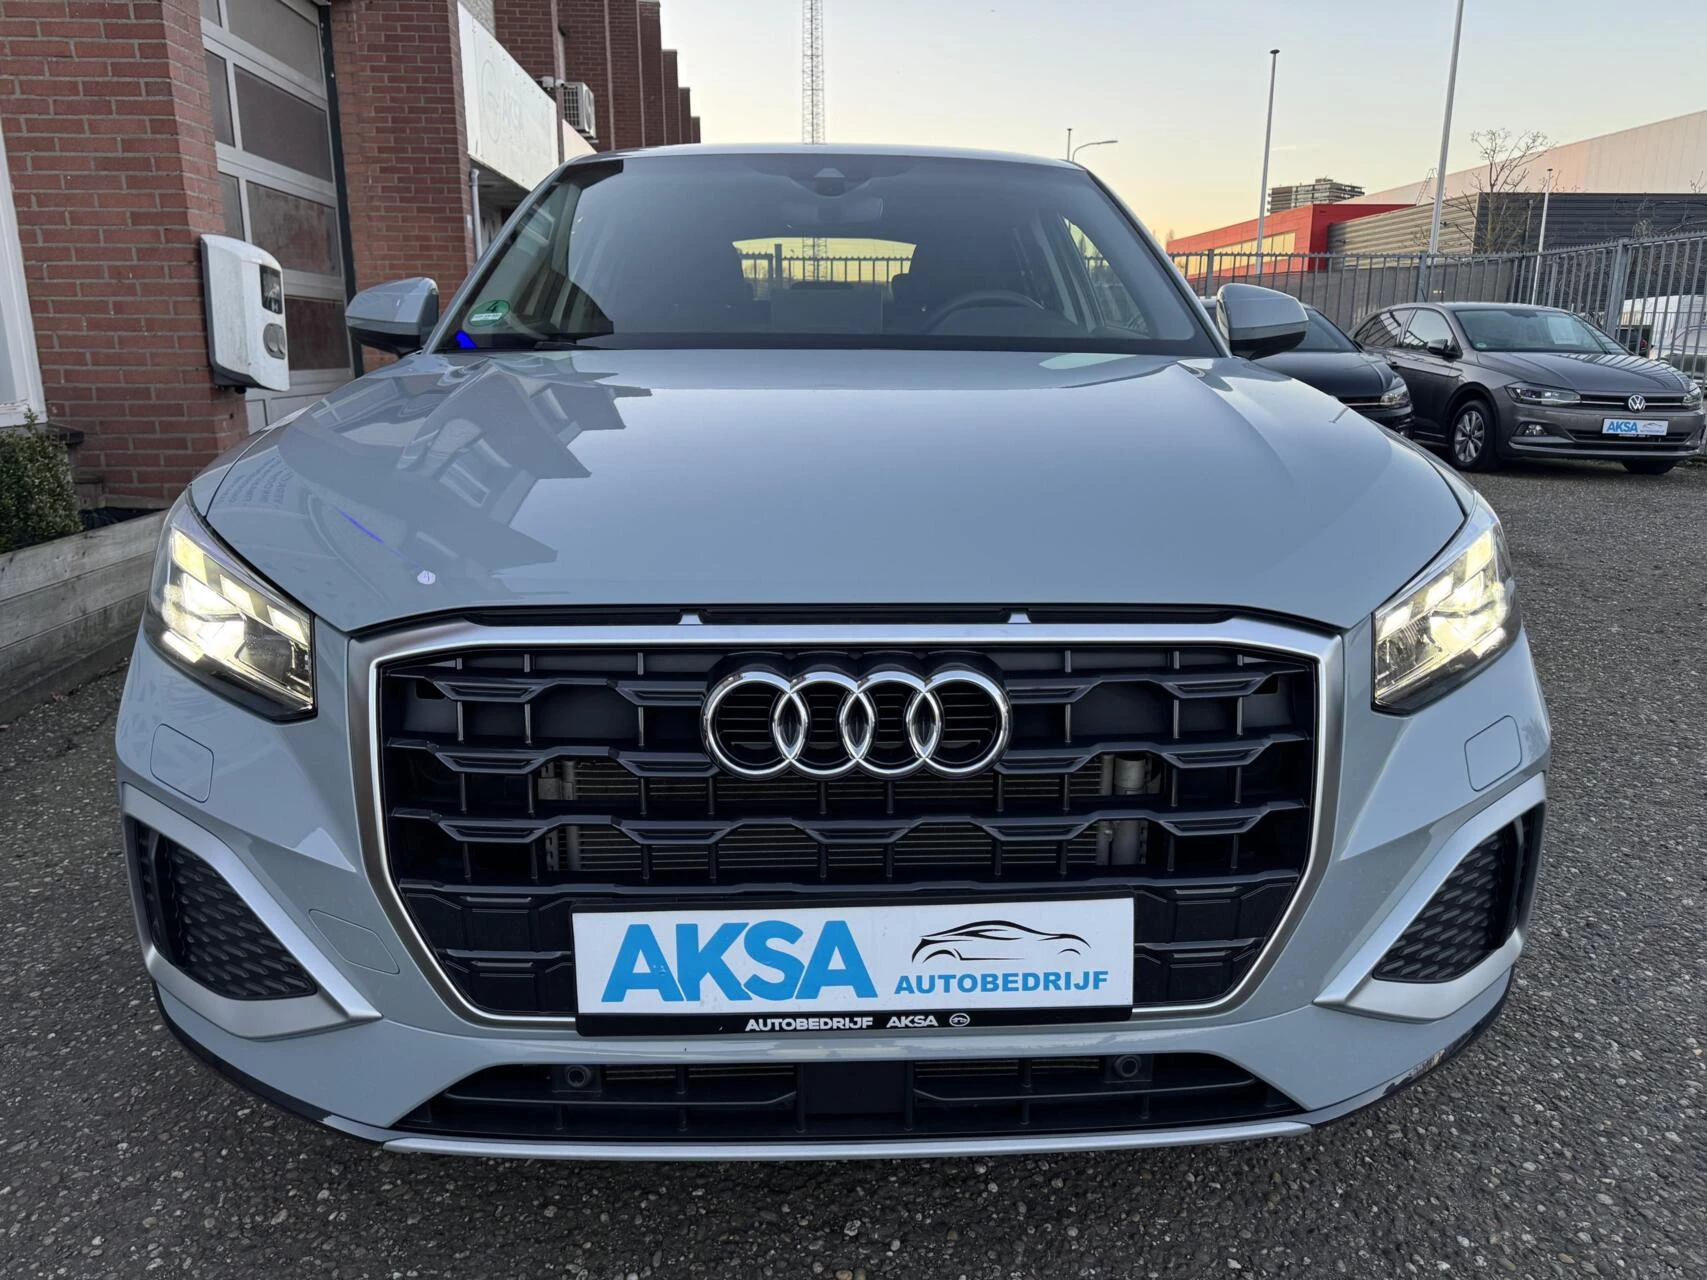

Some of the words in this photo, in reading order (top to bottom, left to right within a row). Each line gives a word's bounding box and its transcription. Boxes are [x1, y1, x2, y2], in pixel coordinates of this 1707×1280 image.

[1606, 421, 1638, 433] AKSA
[600, 919, 879, 1003] AKSA
[894, 970, 1109, 995] AUTOBEDRIJF
[745, 1016, 873, 1032] AUTOBEDRIJF
[886, 1015, 939, 1029] AKSA
